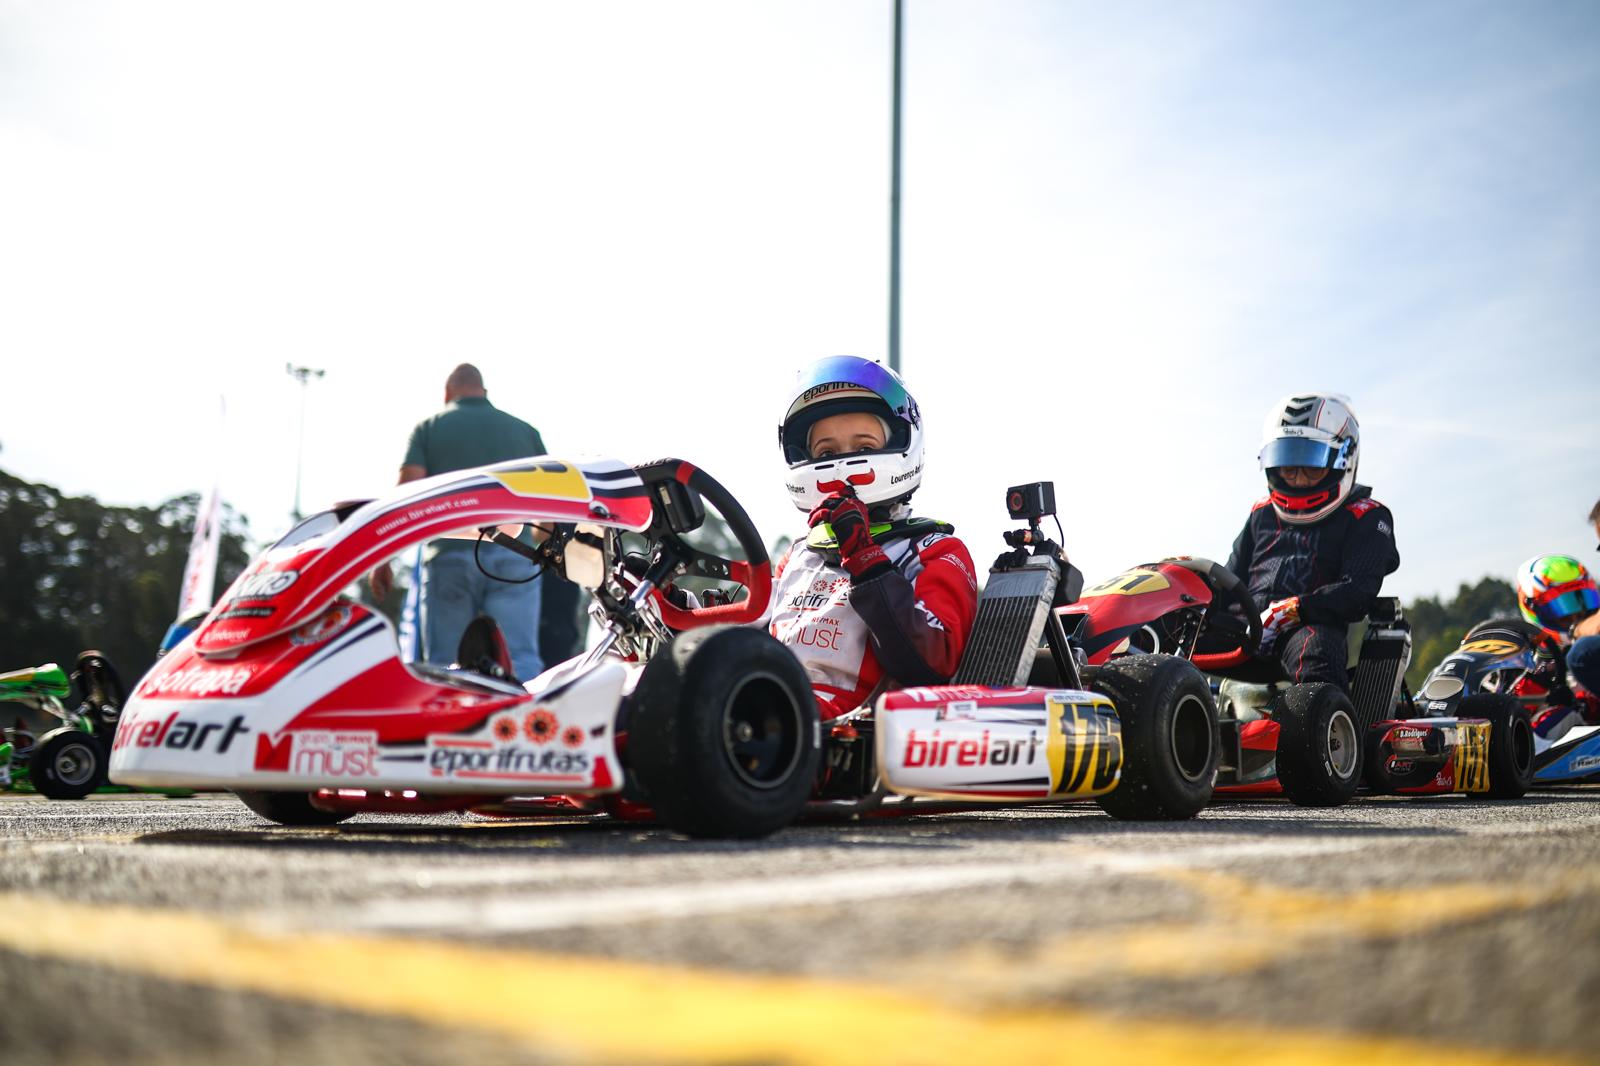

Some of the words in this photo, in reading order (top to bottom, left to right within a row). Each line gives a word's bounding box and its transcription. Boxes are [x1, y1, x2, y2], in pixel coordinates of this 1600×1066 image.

[146, 666, 251, 697] sofrapa
[113, 711, 250, 754] birelart
[903, 728, 1043, 768] birelart
[294, 745, 379, 776] must
[429, 747, 589, 773] eporifrutas
